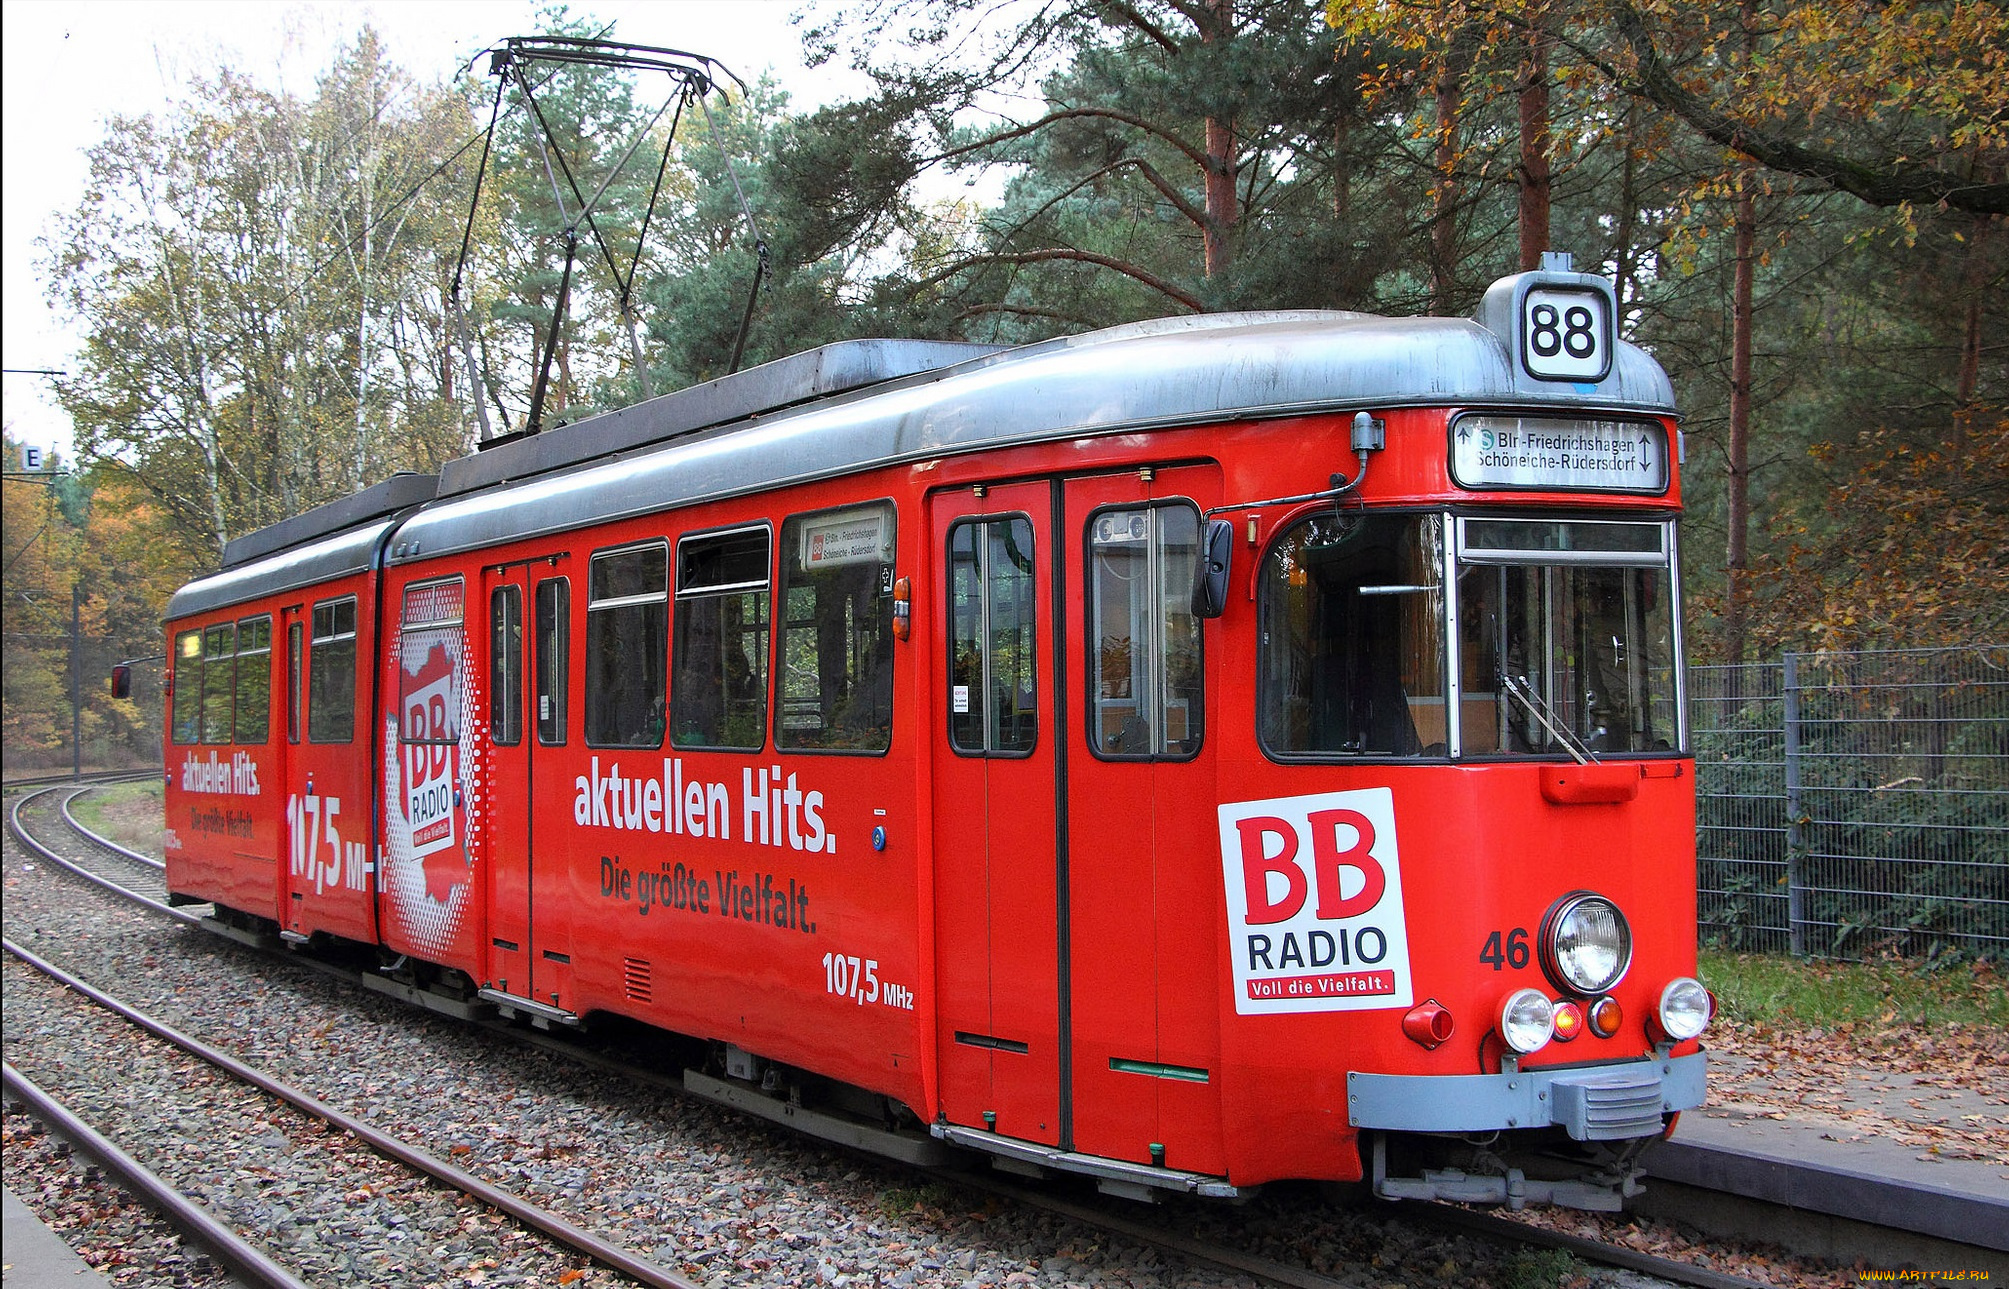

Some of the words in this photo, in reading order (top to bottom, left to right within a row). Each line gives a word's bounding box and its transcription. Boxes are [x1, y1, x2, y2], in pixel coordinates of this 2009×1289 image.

[1531, 304, 1595, 359] 88
[27, 449, 39, 467] E
[410, 693, 447, 789] BB
[183, 750, 231, 793] aktuellen
[233, 750, 260, 795] Hits.
[412, 783, 448, 825] RADIO
[574, 756, 729, 840] aktuellen
[743, 765, 836, 854] Hits.
[1236, 808, 1386, 926] BB
[601, 856, 631, 901] Die
[638, 862, 709, 916] größte
[716, 869, 816, 934] Vielfalt.
[1248, 927, 1387, 971] RADIO
[1479, 928, 1530, 971] 46
[822, 952, 879, 1006] 107,5
[883, 982, 914, 1011] MHz
[1252, 980, 1283, 996] Voll
[1289, 978, 1313, 994] die
[1318, 976, 1389, 993] Vielfalt.
